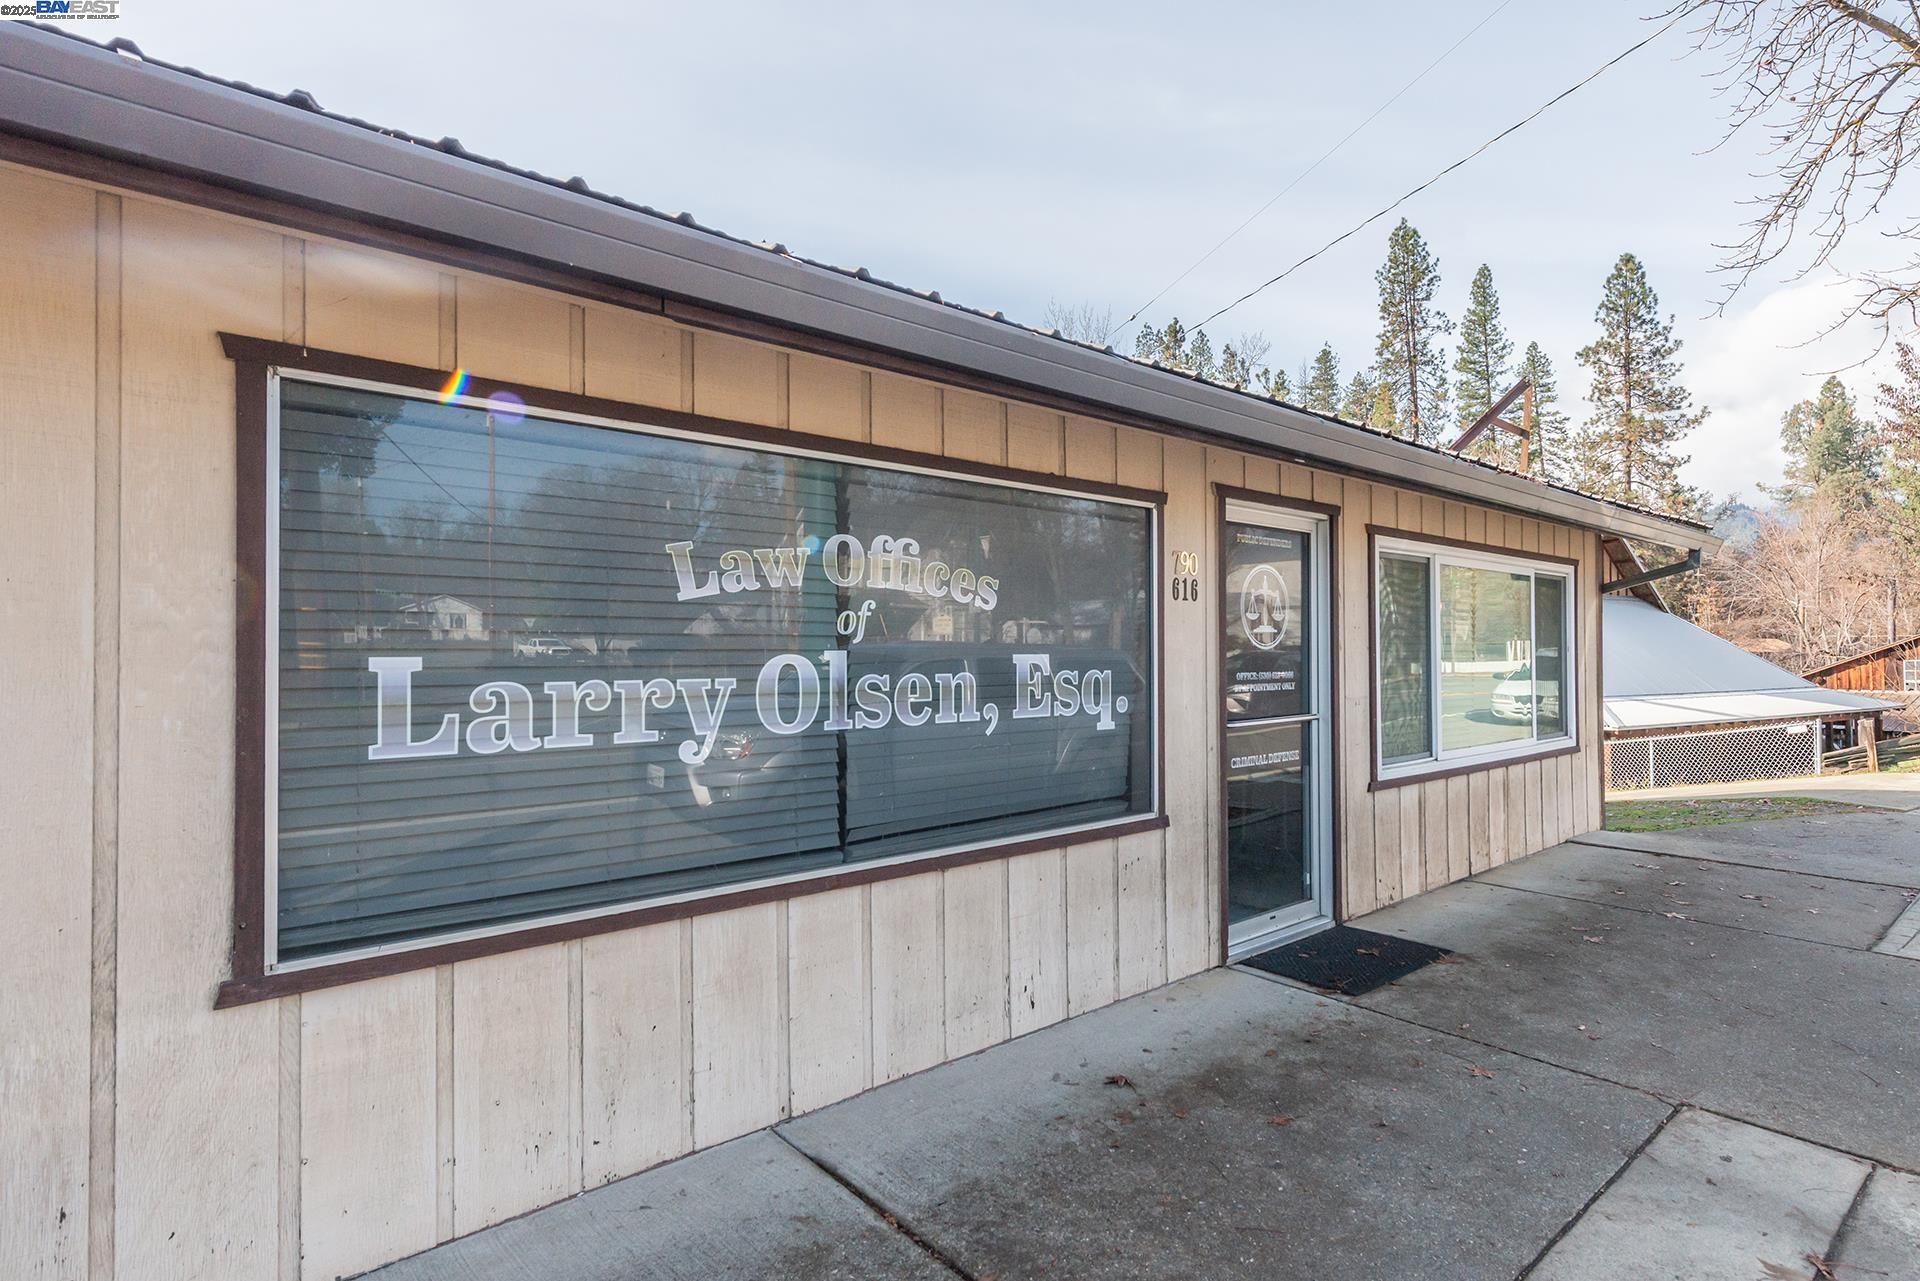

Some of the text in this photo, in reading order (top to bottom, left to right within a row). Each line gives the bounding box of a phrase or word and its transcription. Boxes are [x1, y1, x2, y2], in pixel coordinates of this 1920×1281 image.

[666, 534, 1000, 611] Law Offices
[1172, 551, 1198, 576] 790
[1172, 577, 1198, 602] 616
[836, 600, 873, 644] of
[1282, 681, 1296, 690] ONLY
[367, 650, 1129, 765] Larry Olsen, Esq.
[1231, 750, 1300, 769] CRIMINAL DEFENSE
